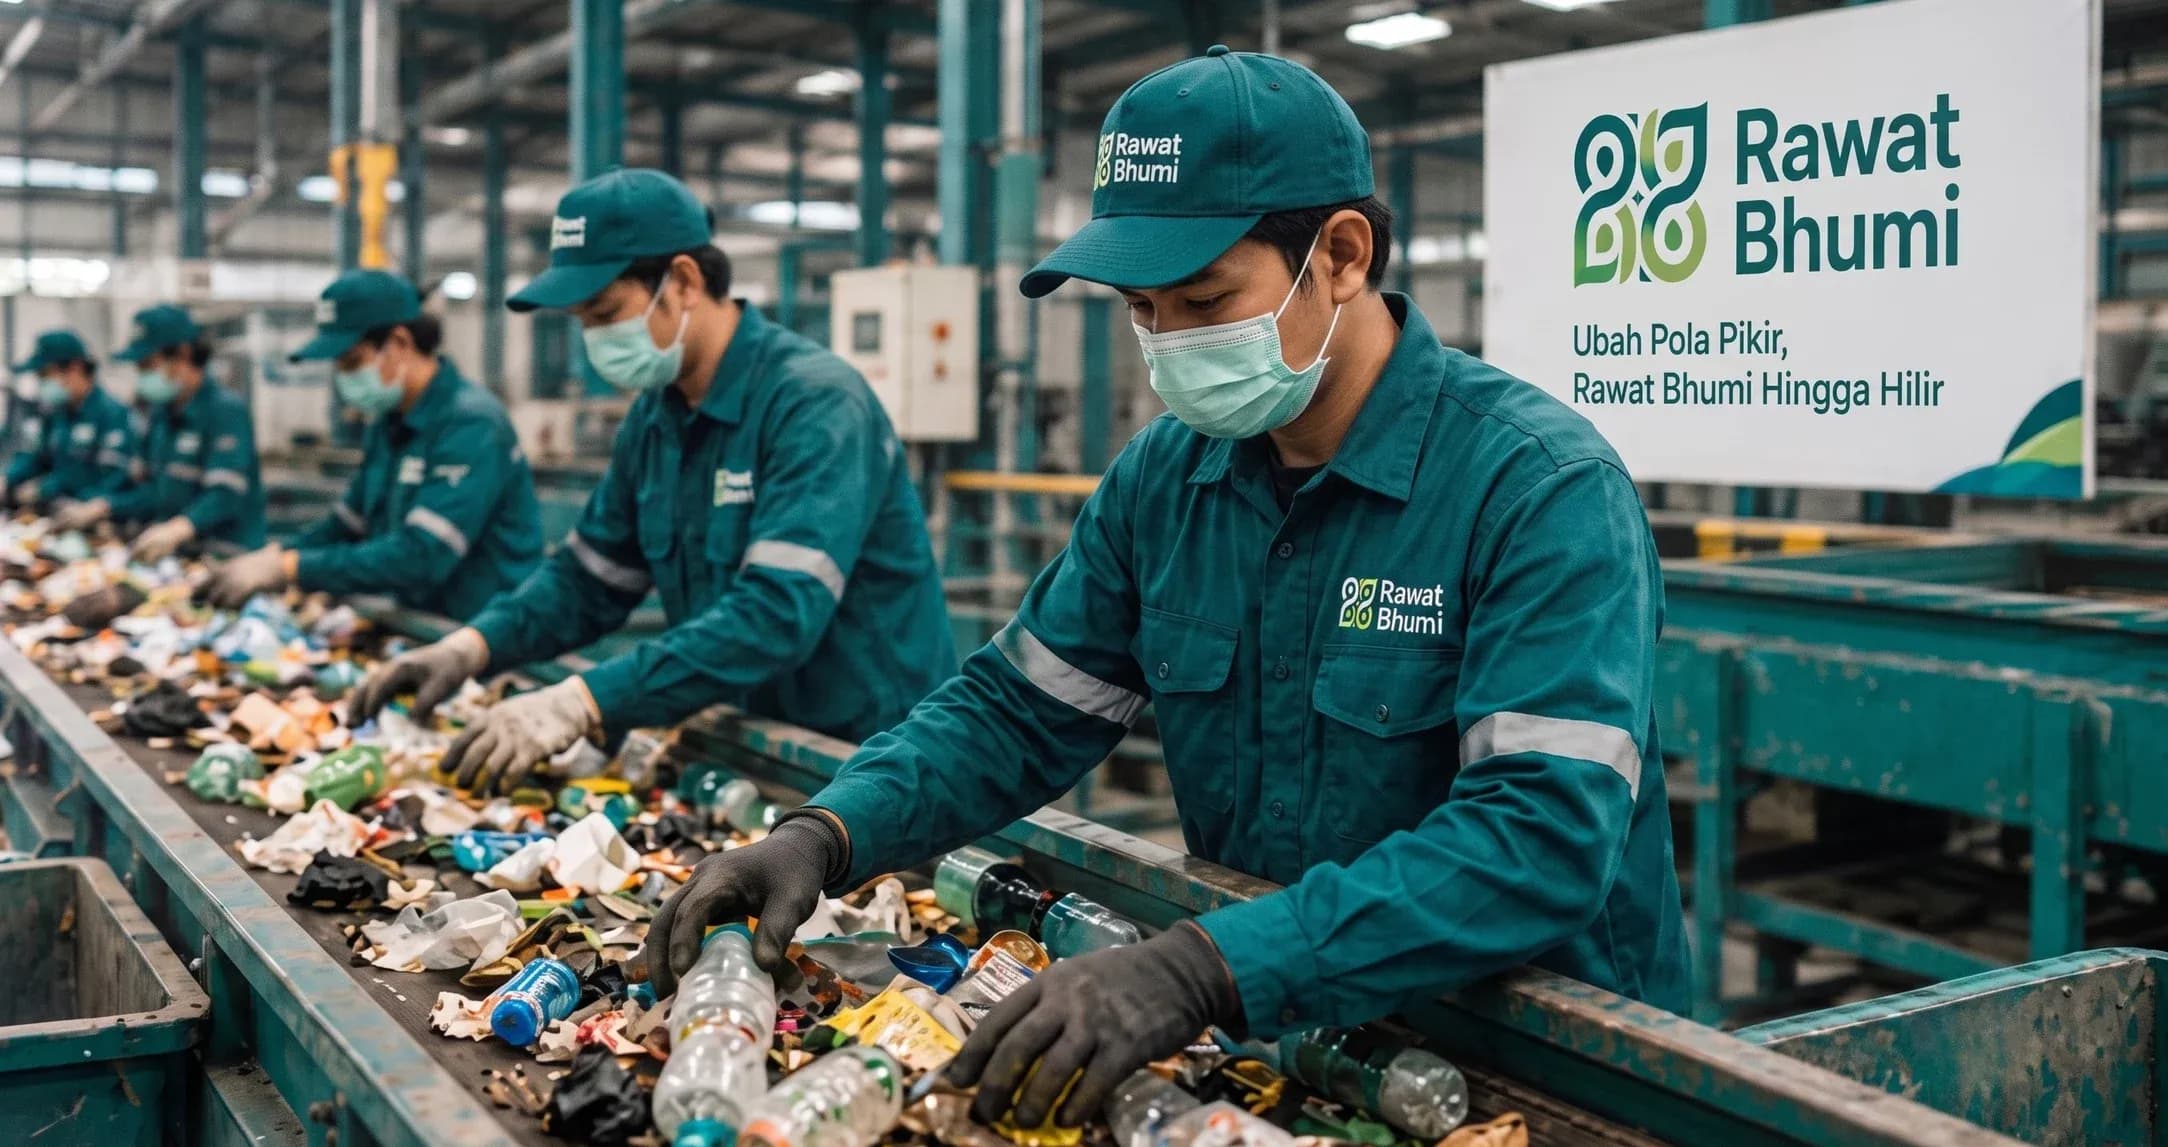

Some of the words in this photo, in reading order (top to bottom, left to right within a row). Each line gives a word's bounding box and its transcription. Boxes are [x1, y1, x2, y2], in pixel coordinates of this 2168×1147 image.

[1115, 132, 1183, 156] Rawat
[1736, 93, 1962, 186] Rawat
[1113, 157, 1179, 184] Bhumi
[1735, 182, 1960, 276] Bhumi
[1573, 323, 1642, 357] Ubah
[1651, 321, 1710, 356] Pola
[1719, 319, 1788, 361] Pikir,
[1573, 372, 1655, 405] Rawat
[1663, 370, 1753, 406] Bhumi
[1762, 370, 1870, 415] Hingga
[1881, 369, 1945, 407] Hilir
[1379, 579, 1444, 607] Rawat
[1376, 606, 1443, 635] Bhumi
